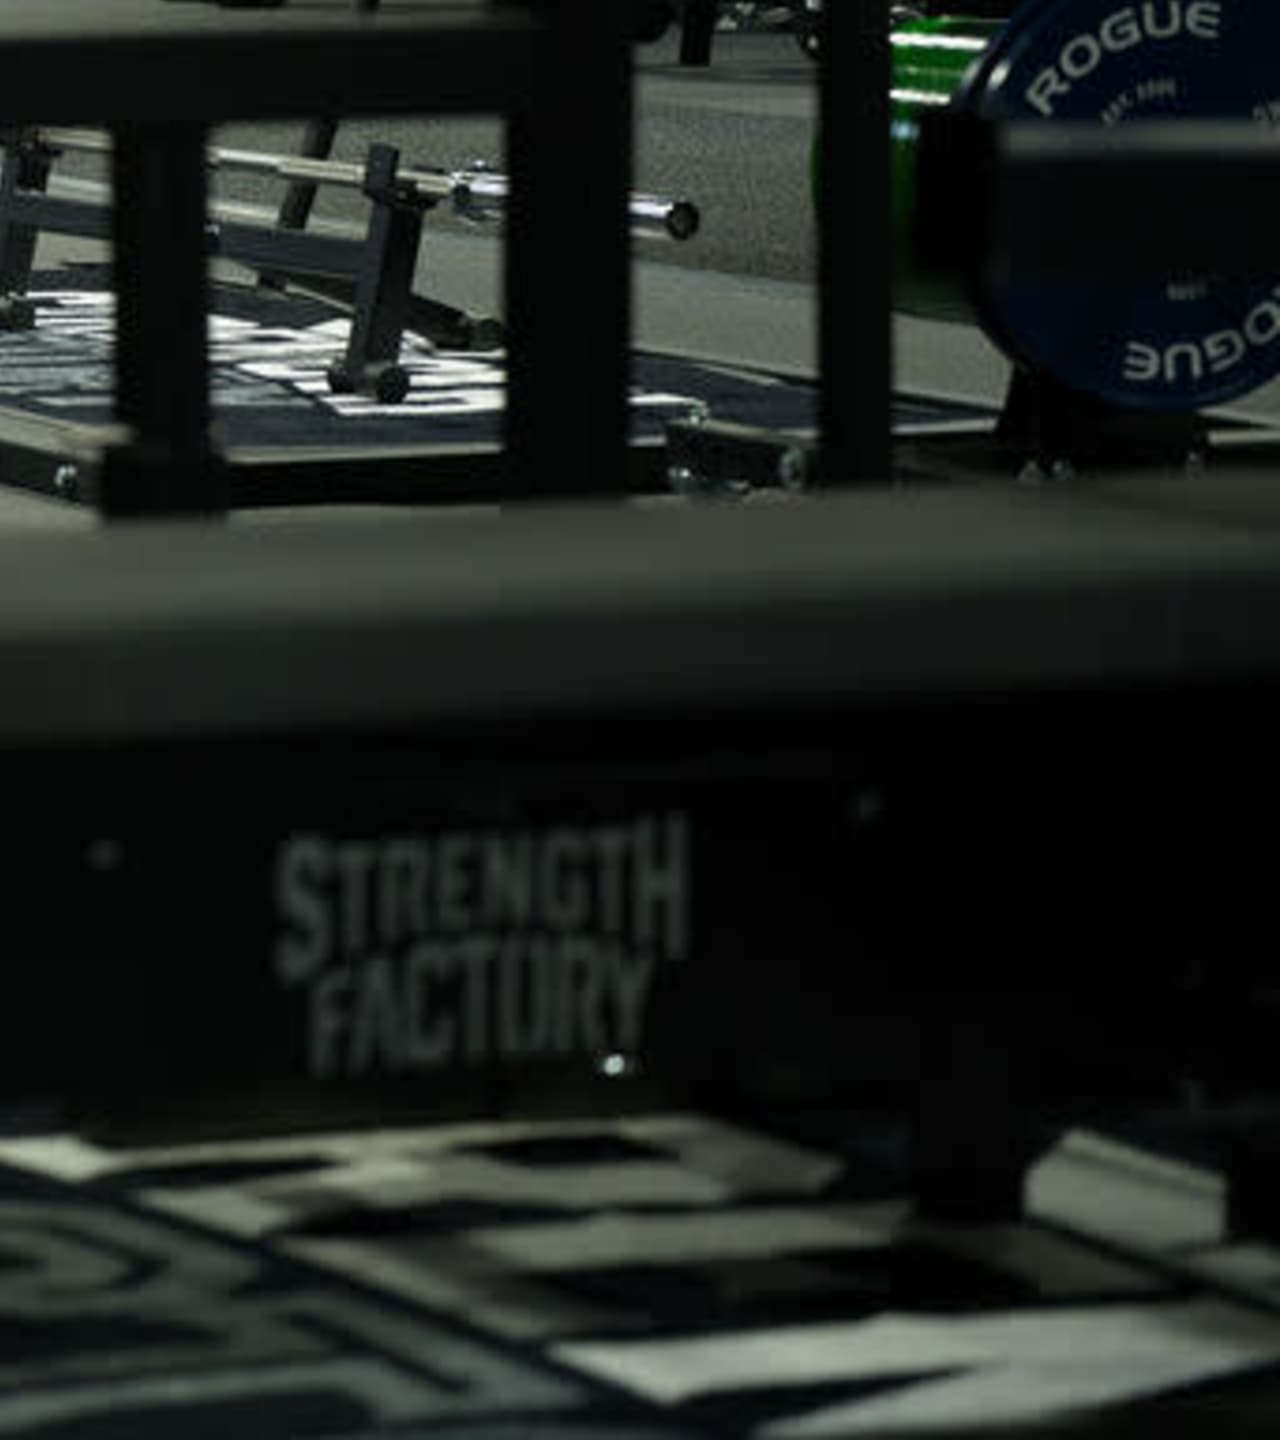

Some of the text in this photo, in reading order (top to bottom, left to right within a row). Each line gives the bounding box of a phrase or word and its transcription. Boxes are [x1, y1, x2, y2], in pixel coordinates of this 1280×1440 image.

[1121, 282, 1280, 383] OGUE
[270, 810, 695, 990] STRENGTH
[306, 930, 657, 1081] FACTORY
